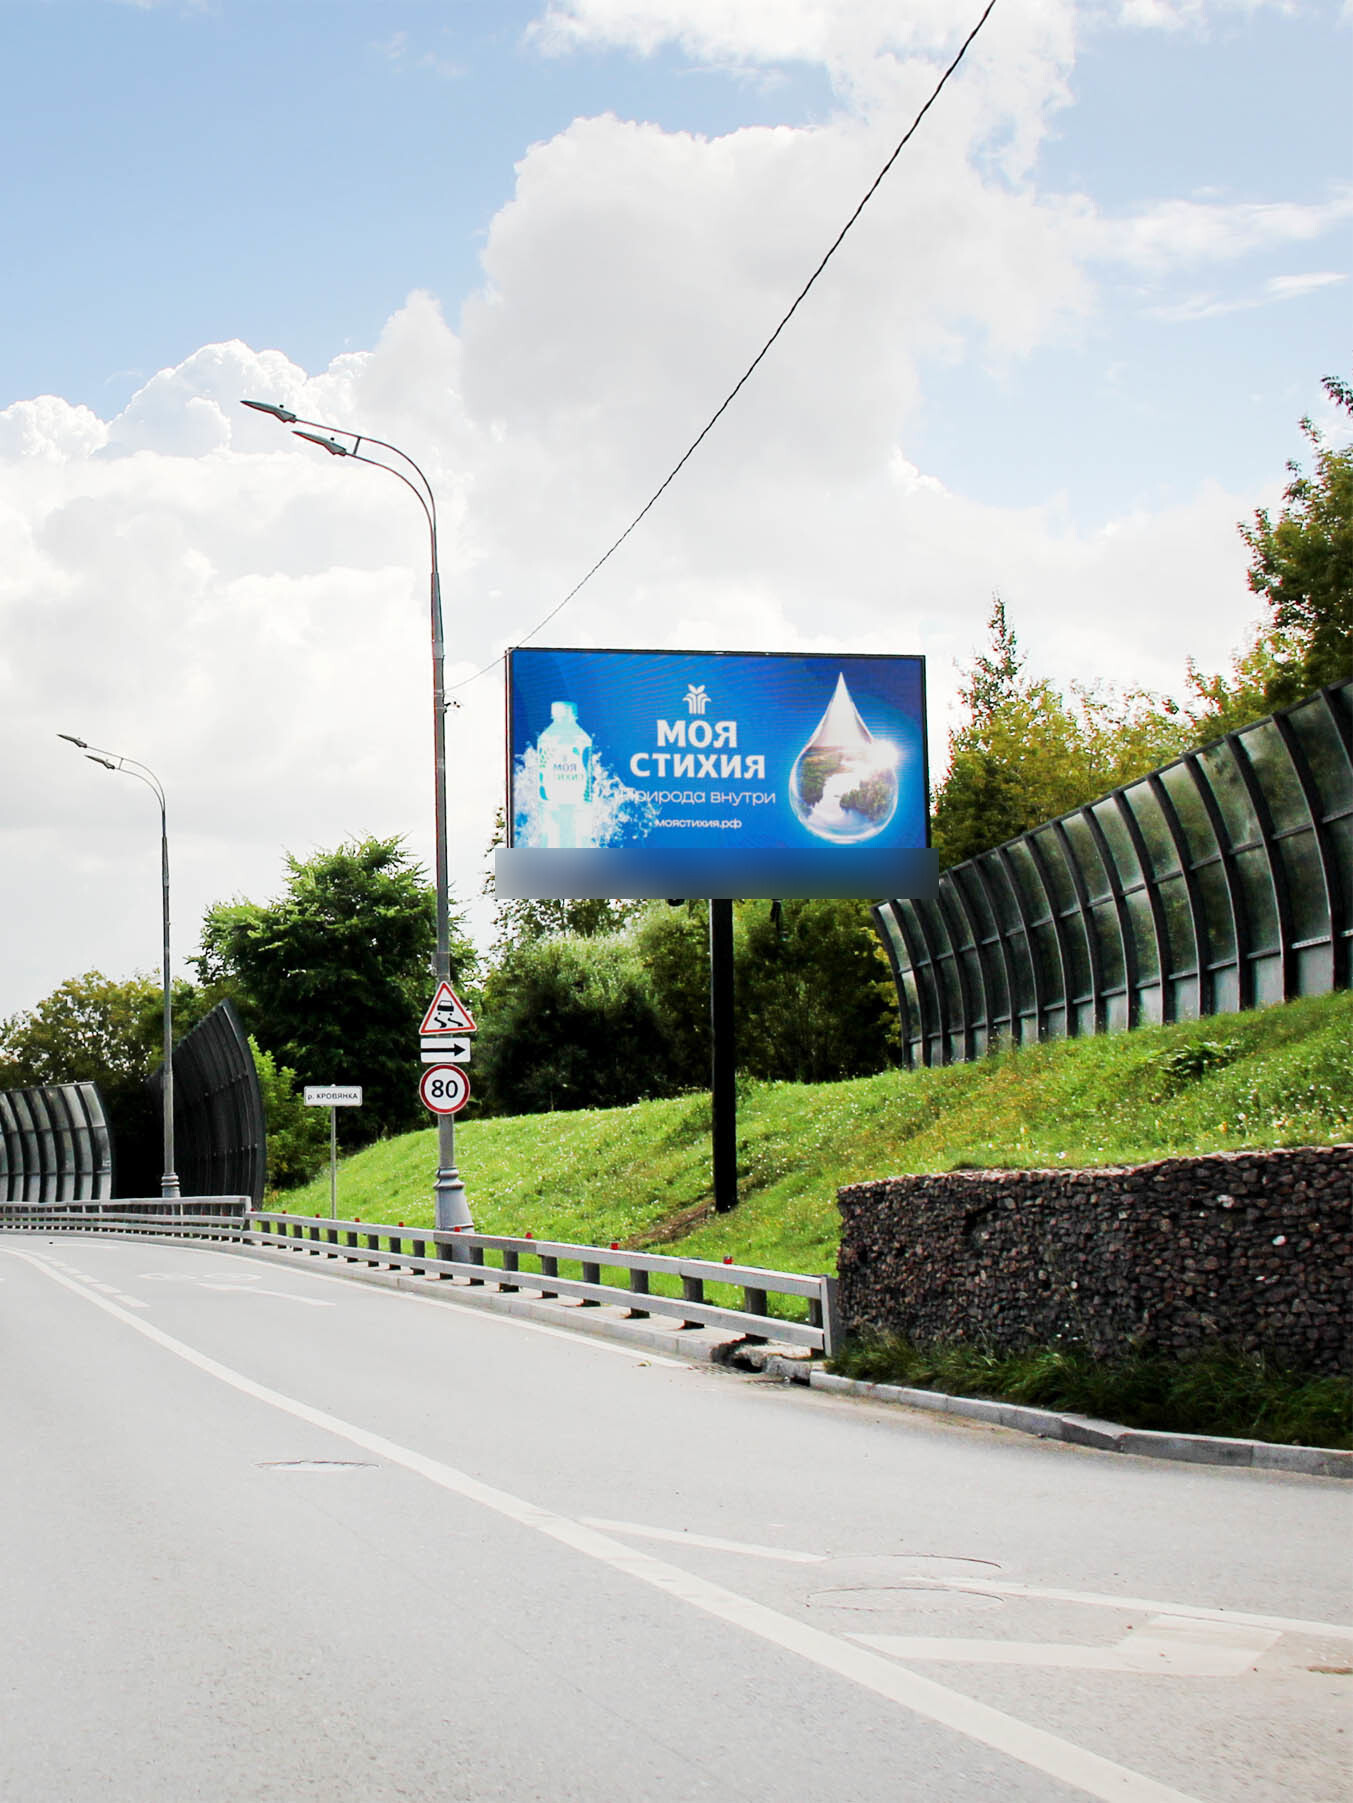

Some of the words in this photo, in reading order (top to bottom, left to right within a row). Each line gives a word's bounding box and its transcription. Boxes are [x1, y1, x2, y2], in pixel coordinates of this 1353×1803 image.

[656, 719, 738, 749] МОЯ
[629, 752, 766, 780] СТИХИЯ
[710, 791, 777, 806] внутри
[655, 818, 743, 830] моястихия.рф
[431, 1079, 459, 1099] 80
